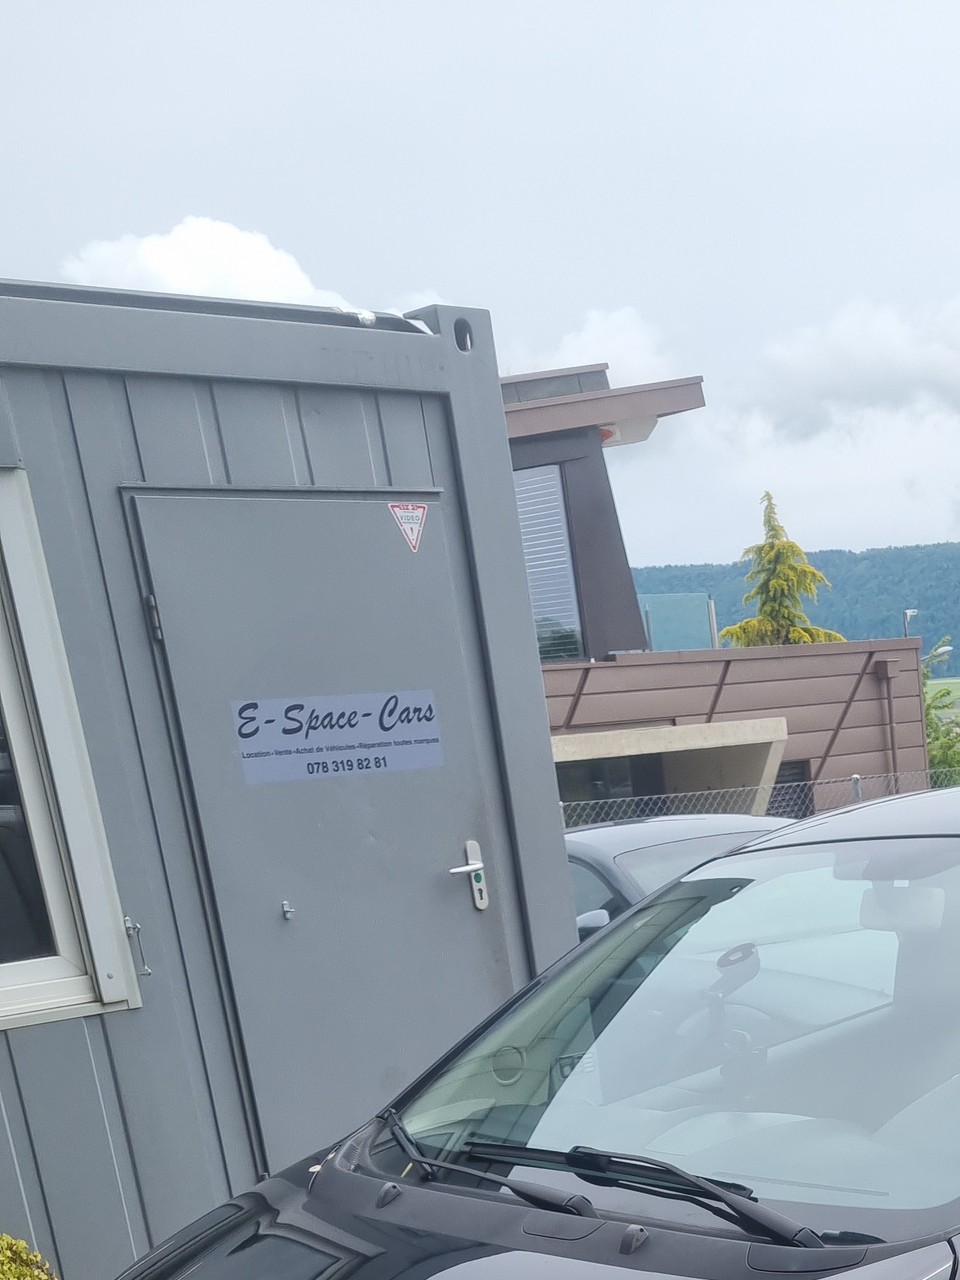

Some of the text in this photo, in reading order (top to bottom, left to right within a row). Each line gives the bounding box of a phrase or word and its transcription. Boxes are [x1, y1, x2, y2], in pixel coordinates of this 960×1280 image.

[307, 756, 388, 775] 078 319 82 81
